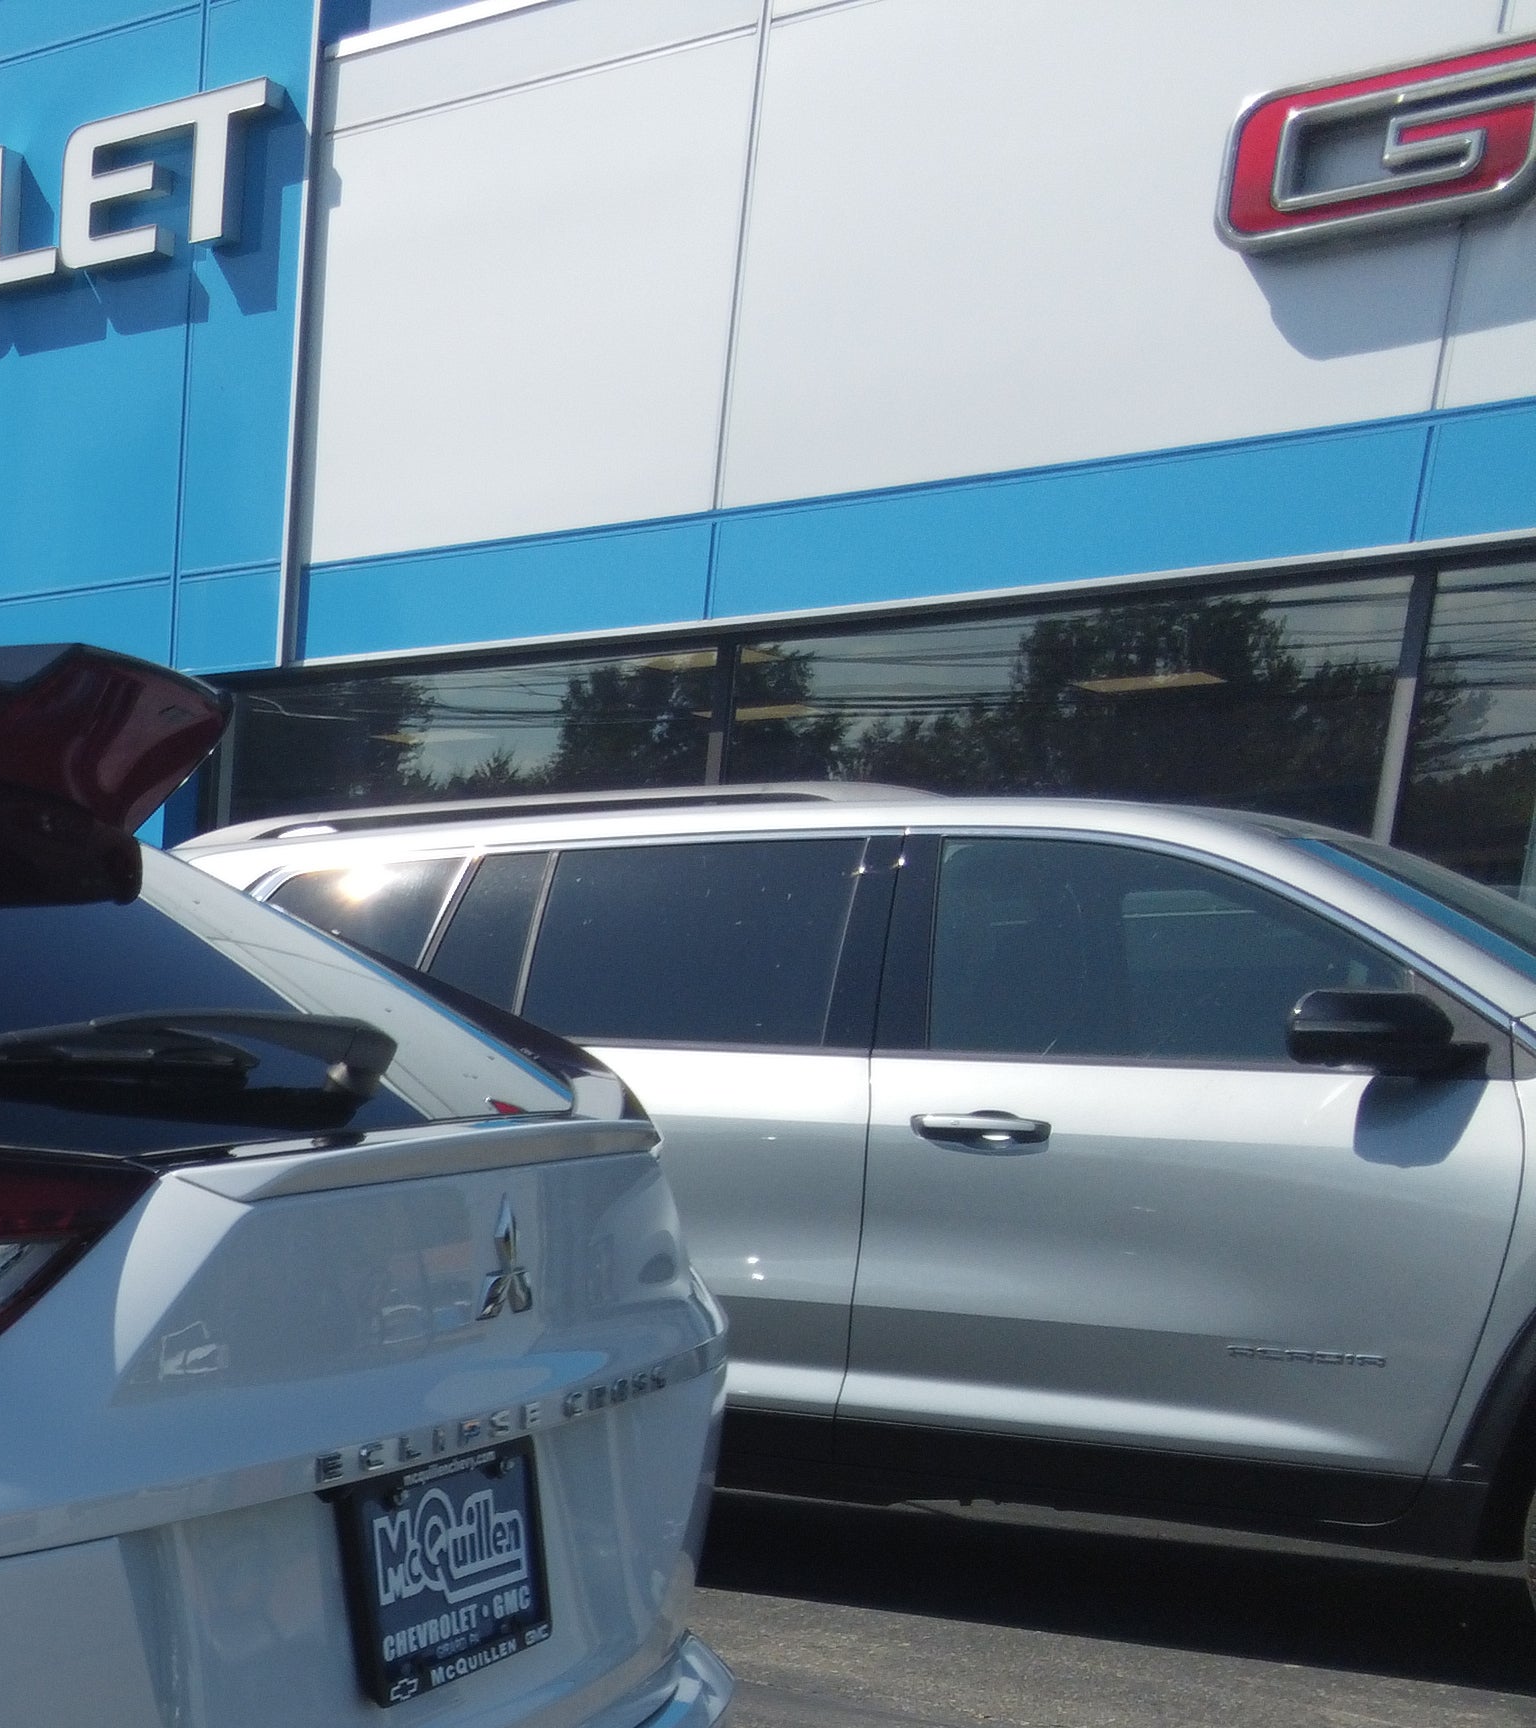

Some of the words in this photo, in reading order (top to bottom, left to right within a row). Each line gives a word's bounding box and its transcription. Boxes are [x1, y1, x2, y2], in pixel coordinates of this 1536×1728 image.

[1214, 33, 1536, 254] G
[315, 1401, 542, 1483] ECLIPSE
[562, 1365, 666, 1418] CROSS
[372, 1487, 529, 1606] McQuillen
[383, 1603, 478, 1662] CHEVROLET
[491, 1585, 531, 1619] GMC
